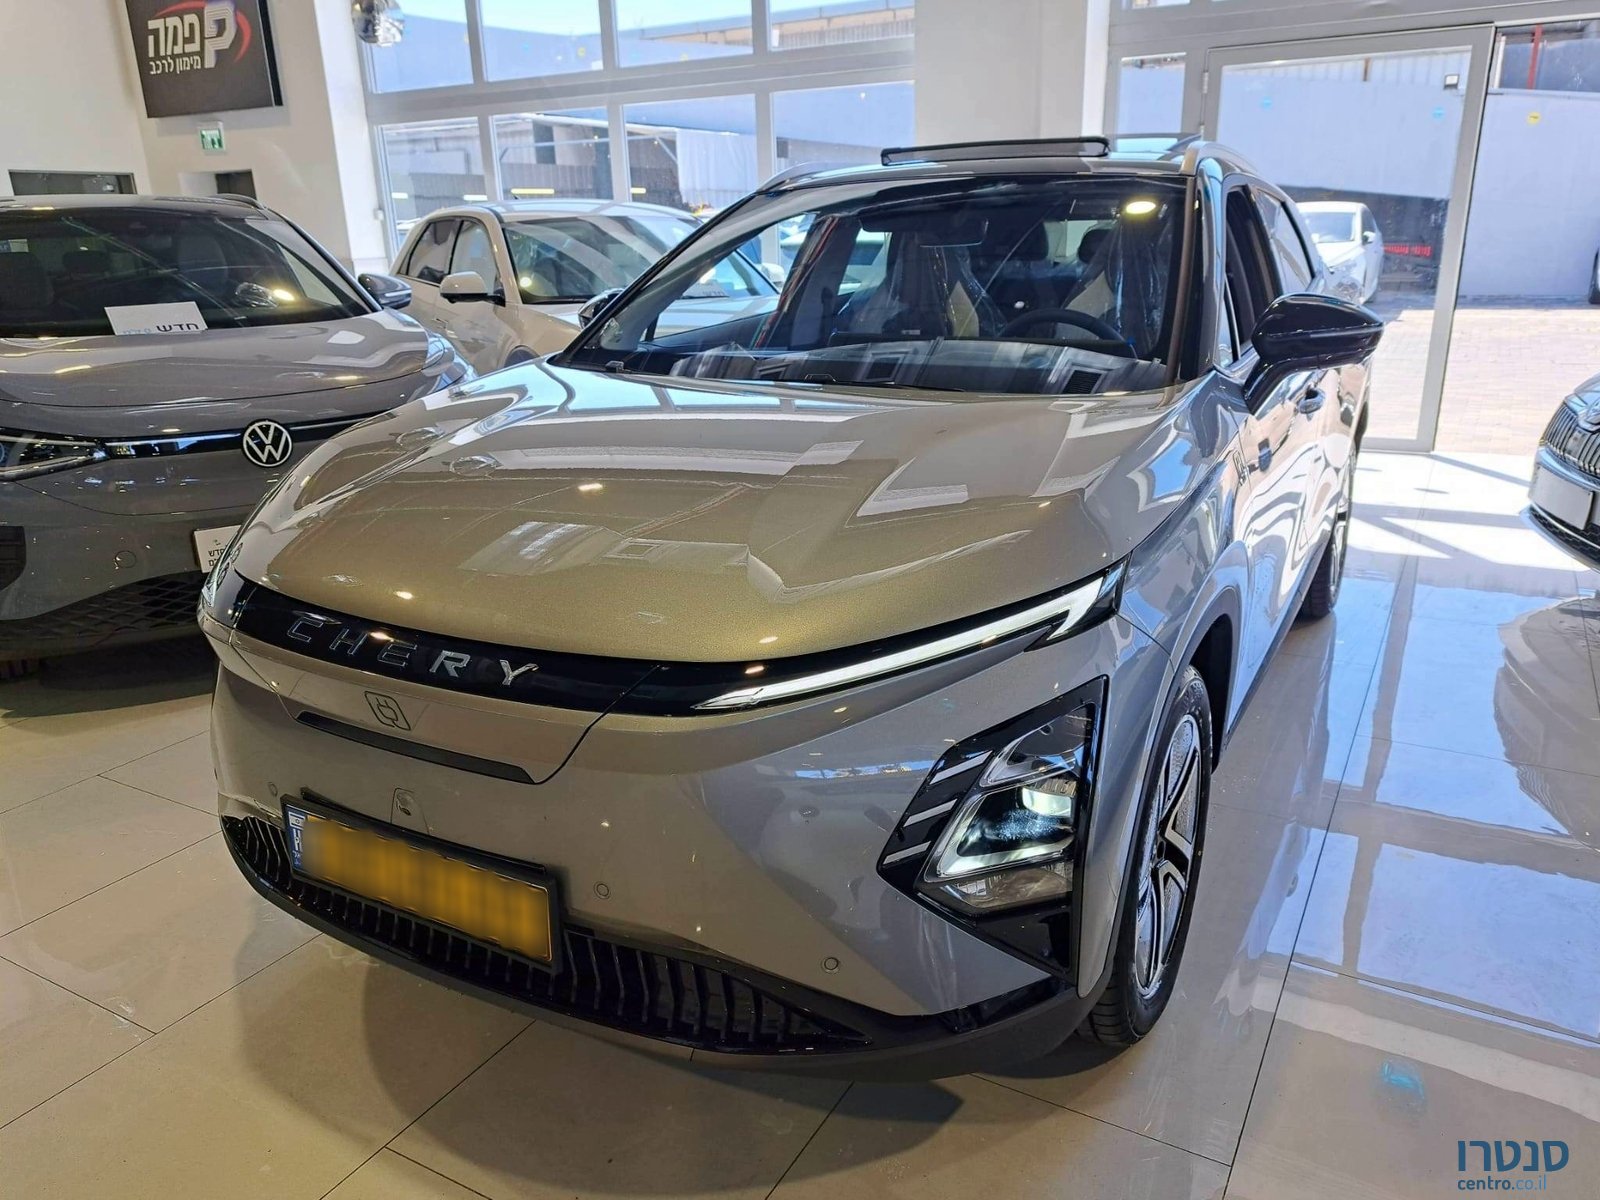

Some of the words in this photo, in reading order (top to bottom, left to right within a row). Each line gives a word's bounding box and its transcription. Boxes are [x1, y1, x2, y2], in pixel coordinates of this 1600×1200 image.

[147, 13, 201, 58] פמה
[149, 56, 175, 75] לרכב
[176, 55, 202, 74] מימון
[156, 323, 199, 332] חדש
[286, 614, 540, 686] CHERY
